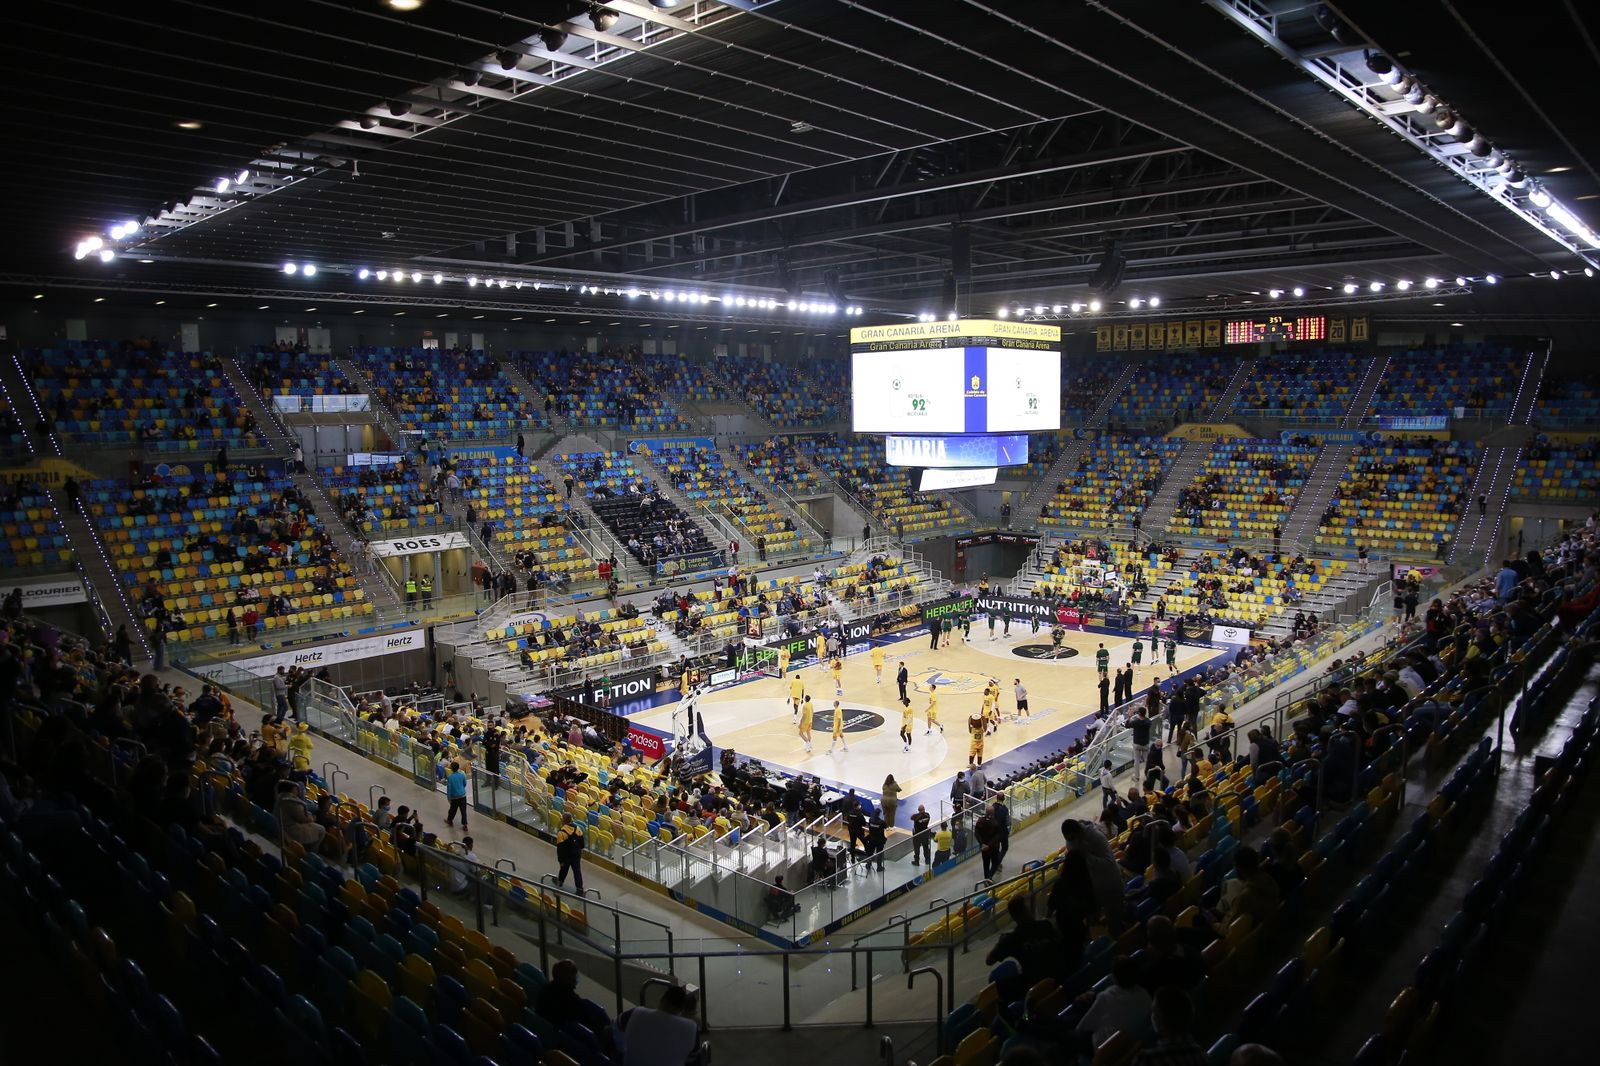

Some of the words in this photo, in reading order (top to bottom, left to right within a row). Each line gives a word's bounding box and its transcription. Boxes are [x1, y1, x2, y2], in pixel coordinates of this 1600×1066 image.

[861, 329, 884, 339] GRAN
[886, 327, 925, 337] CANARIA
[929, 323, 961, 334] ARENA
[993, 324, 1011, 333] GRAN
[1012, 325, 1037, 335] CANARIA
[1331, 327, 1343, 338] 20
[870, 342, 888, 351] Gran
[889, 341, 917, 350] Canaria
[1001, 339, 1016, 347] Gran
[393, 538, 441, 551] ROES
[1, 586, 81, 598] HLCOURIER
[977, 598, 1050, 616] NUTRITION
[1057, 609, 1080, 617] endes
[509, 618, 539, 627] DIELCA
[387, 635, 412, 648] Hertz
[294, 650, 323, 664] Hertz
[627, 732, 659, 751] endesa
